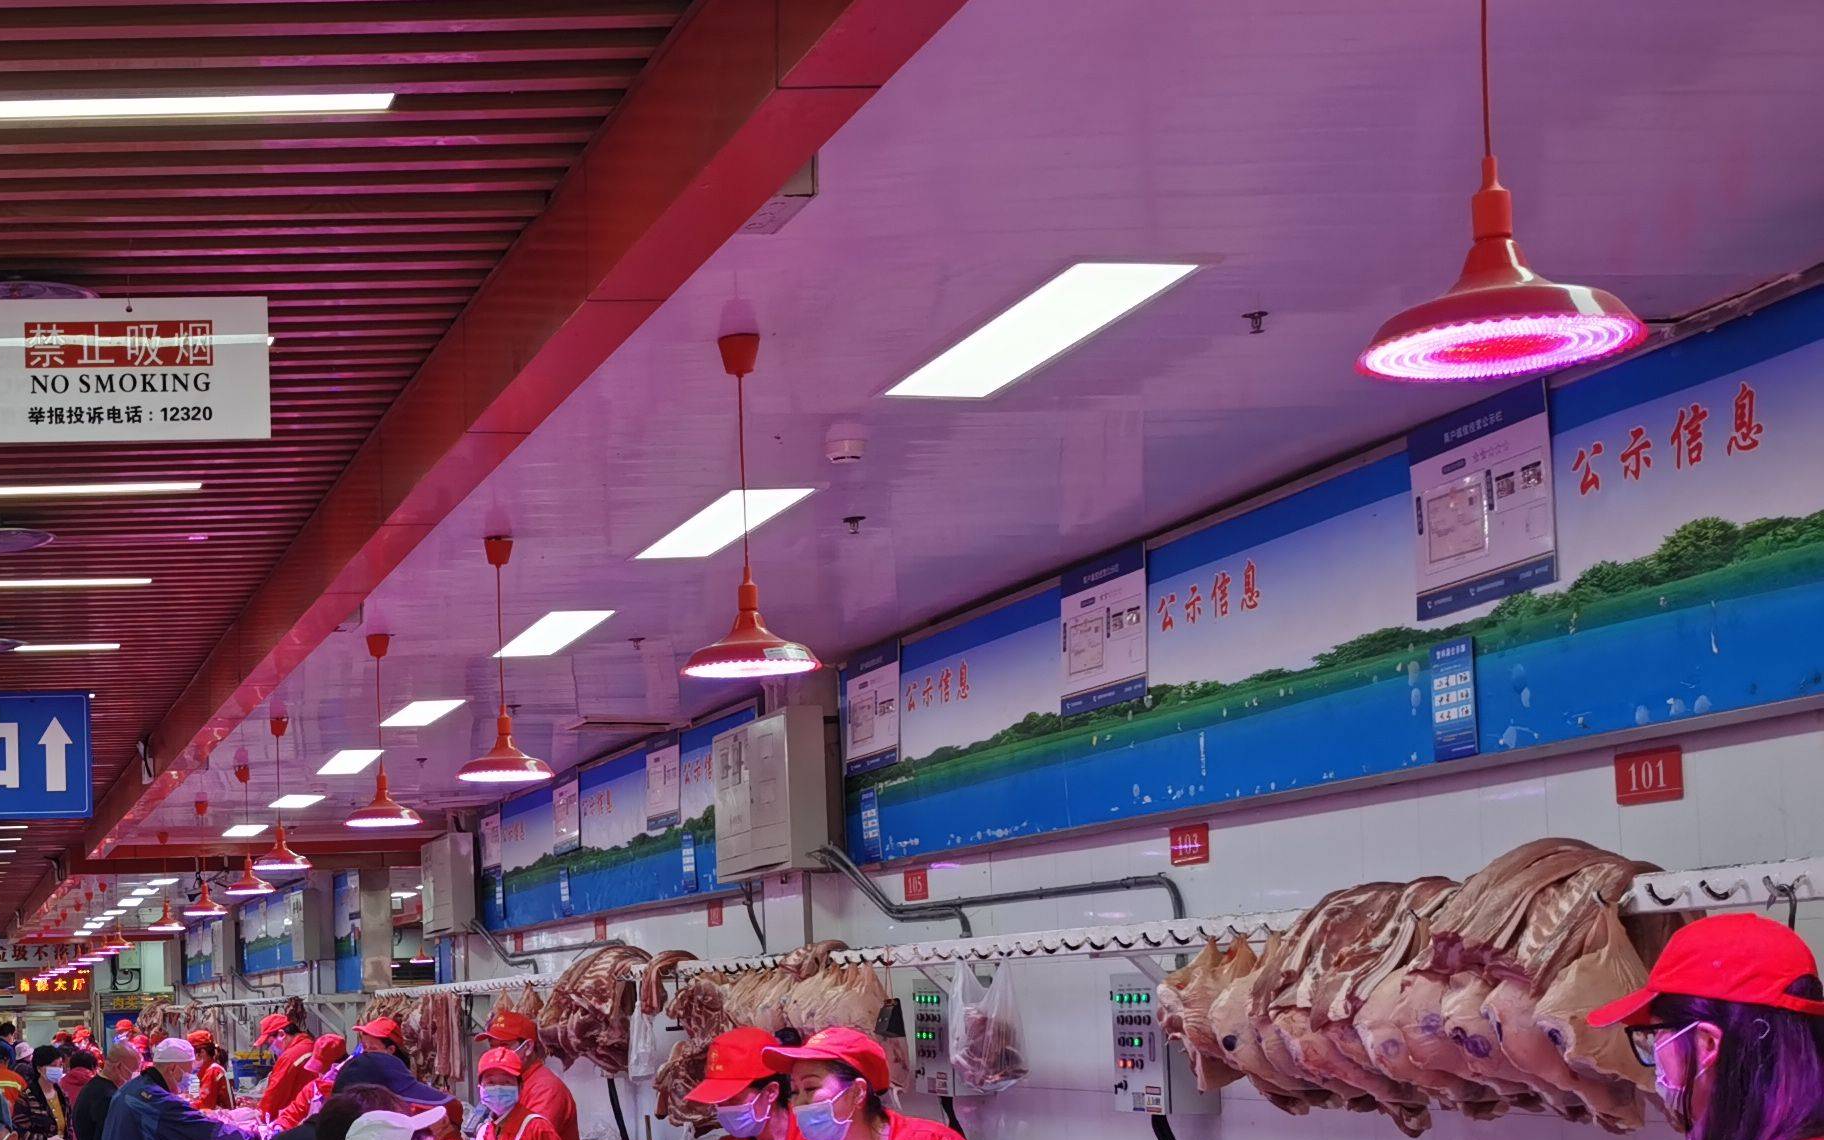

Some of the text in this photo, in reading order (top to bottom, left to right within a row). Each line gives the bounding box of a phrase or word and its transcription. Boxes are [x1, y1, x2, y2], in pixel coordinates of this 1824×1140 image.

[29, 322, 212, 368] 禁止吸烟
[30, 373, 211, 394] NO SMOKING
[1572, 382, 1765, 496] 公示信息
[1156, 559, 1261, 633] 公示信息
[905, 659, 971, 712] 公示信息
[1627, 759, 1668, 791] 101
